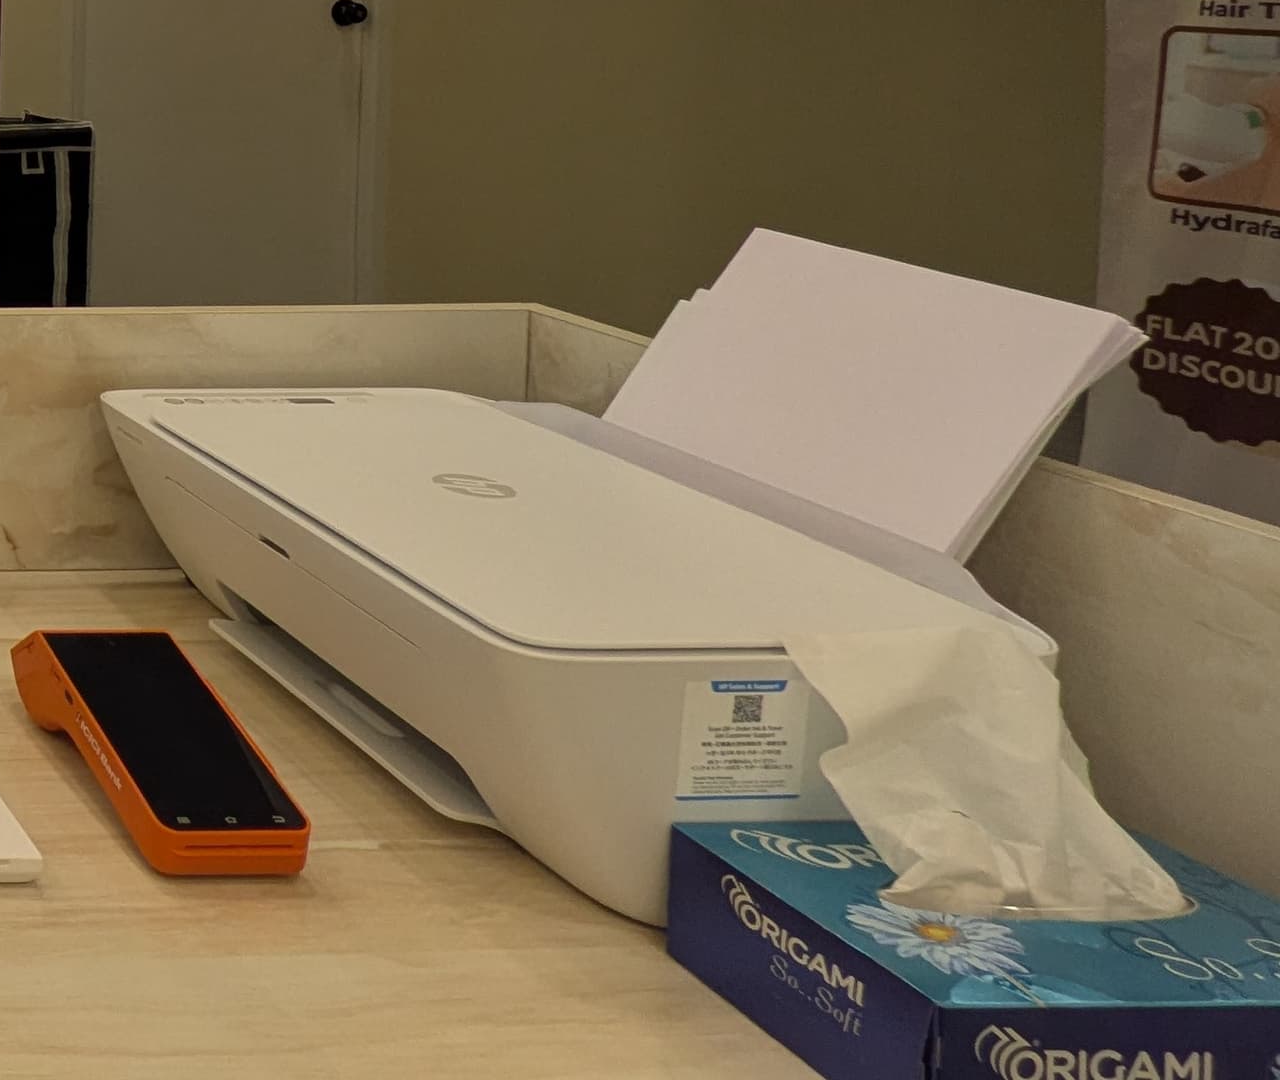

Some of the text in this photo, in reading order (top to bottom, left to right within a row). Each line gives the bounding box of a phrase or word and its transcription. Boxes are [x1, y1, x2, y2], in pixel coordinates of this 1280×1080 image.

[1199, 0, 1251, 18] Hair
[1170, 207, 1280, 240] Hydrafa
[1145, 314, 1280, 361] FLAT 20
[1142, 347, 1280, 398] DISCOU
[100, 752, 122, 790] Bank
[739, 904, 865, 1008] ORIGAMI
[1008, 1047, 1213, 1080] ORIGAMI
